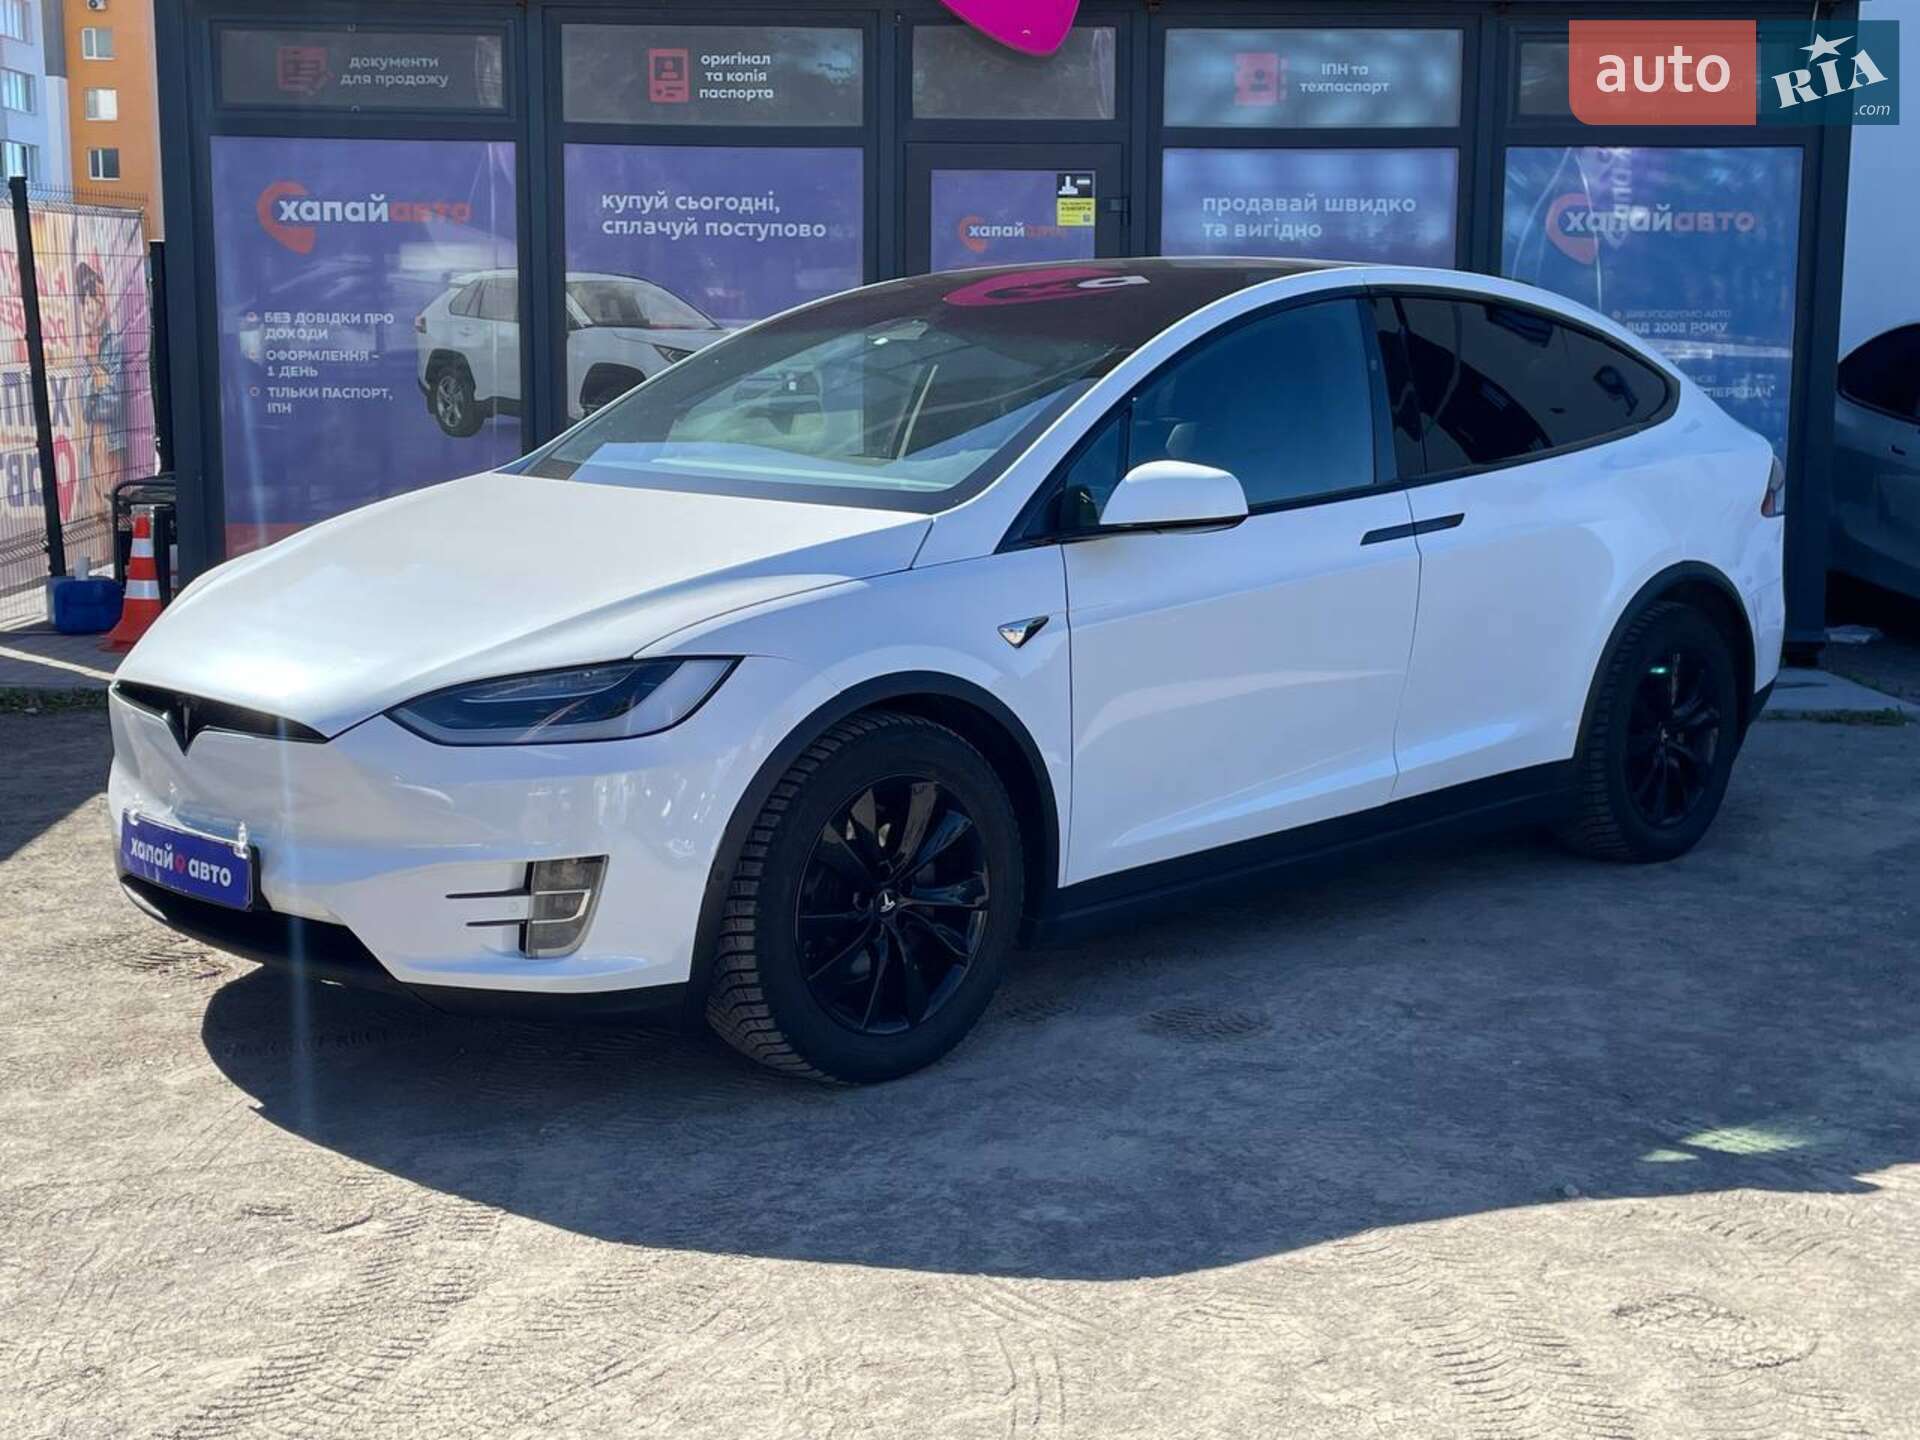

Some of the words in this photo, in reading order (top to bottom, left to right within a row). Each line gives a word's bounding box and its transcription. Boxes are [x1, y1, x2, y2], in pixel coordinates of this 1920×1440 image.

[350, 57, 439, 70] документи
[701, 52, 771, 67] оригінал
[705, 72, 723, 82] та
[727, 69, 767, 82] копія
[1321, 63, 1348, 75] ІПН
[1351, 65, 1369, 75] та
[340, 74, 372, 86] для
[375, 75, 449, 88] продажу
[700, 88, 774, 101] паспорта
[1300, 82, 1390, 95] техпаспорт
[602, 190, 669, 214] купуй
[675, 190, 781, 214] сьогодні,
[1202, 193, 1317, 216] продавай
[1325, 197, 1417, 216] швидко
[602, 217, 698, 240] сплачуй
[705, 222, 827, 242] поступово
[1202, 223, 1227, 238] та
[1235, 217, 1322, 240] вигідно
[264, 312, 291, 323] БЕЗ
[294, 312, 361, 326] ДОВІДКИ
[364, 313, 394, 324] ПРО
[264, 328, 329, 341] ДОХОДИ
[1690, 322, 1728, 334] РОКУ
[265, 350, 369, 361] ОФОРМЛЕННЯ
[267, 366, 275, 377] 1
[279, 366, 319, 379] ДЕНЬ
[268, 387, 319, 399] ТІЛЬКИ
[322, 387, 394, 400] ПАСПОРТ,
[267, 402, 292, 414] ІПН
[130, 838, 174, 870] хапай
[188, 858, 232, 887] авто
